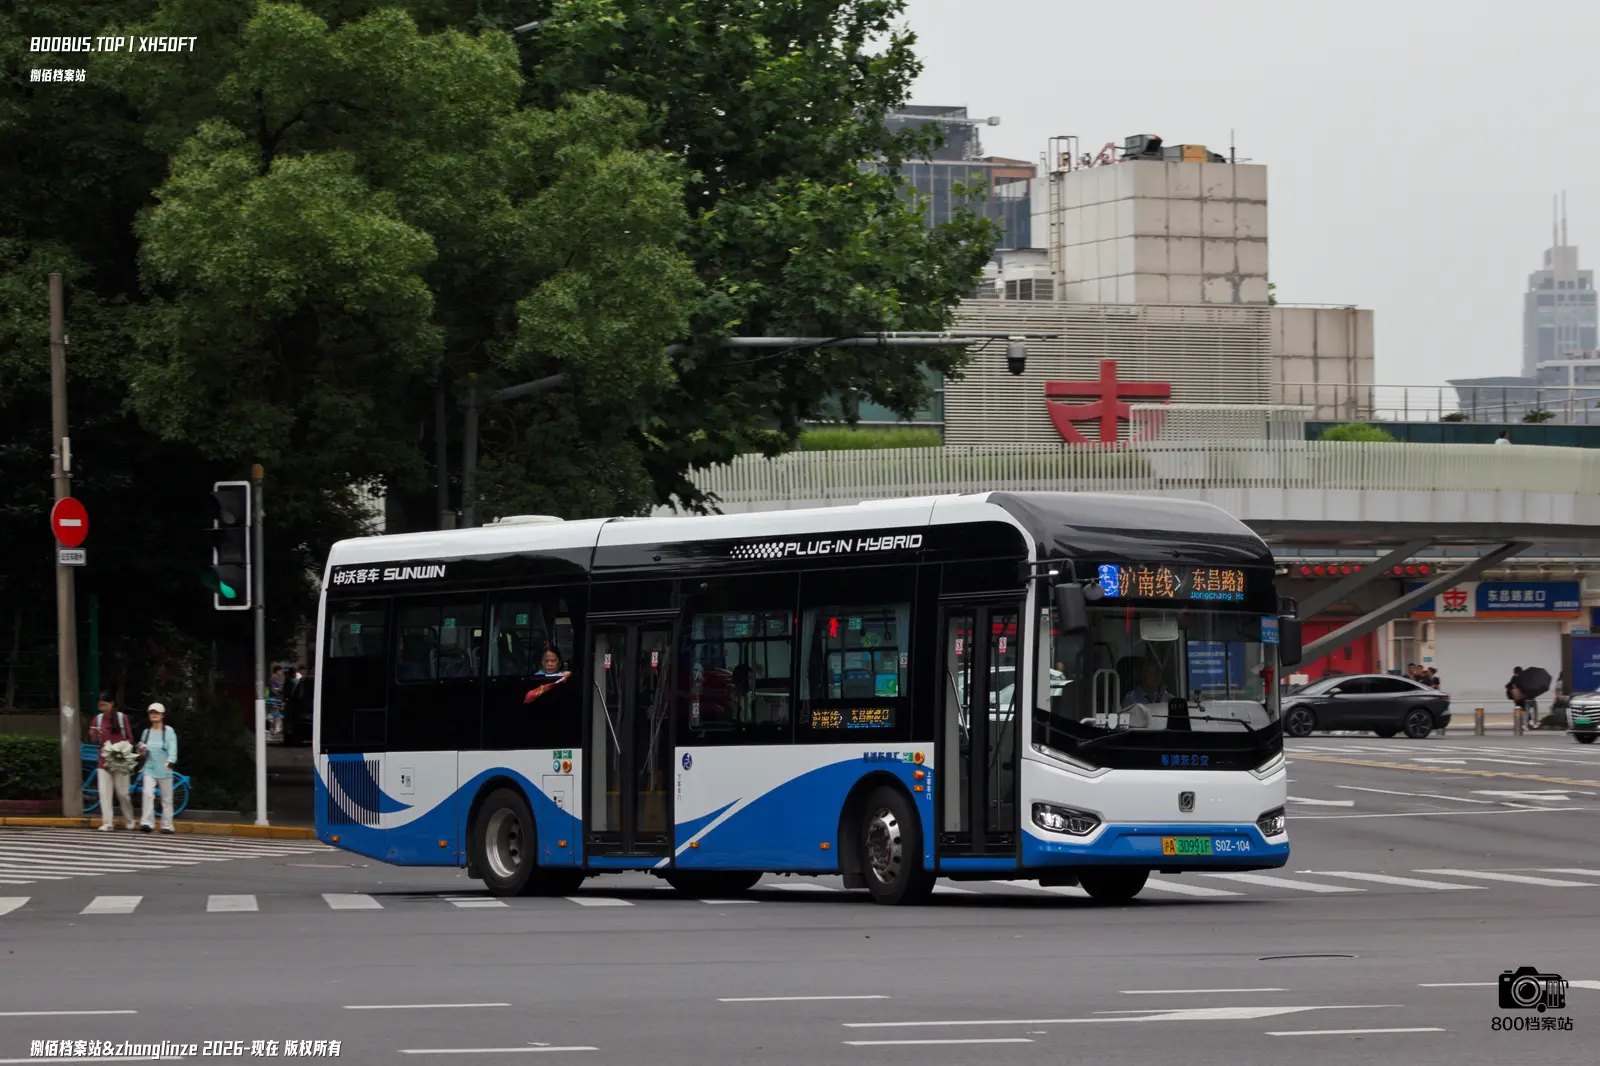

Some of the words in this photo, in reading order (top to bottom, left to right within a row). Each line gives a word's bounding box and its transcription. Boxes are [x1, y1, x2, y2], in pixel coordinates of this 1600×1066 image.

[784, 538, 853, 556] PLUG-IN
[856, 534, 923, 552] HYBRID
[333, 568, 380, 585] 申沃客车
[383, 565, 446, 581] SUNWIN
